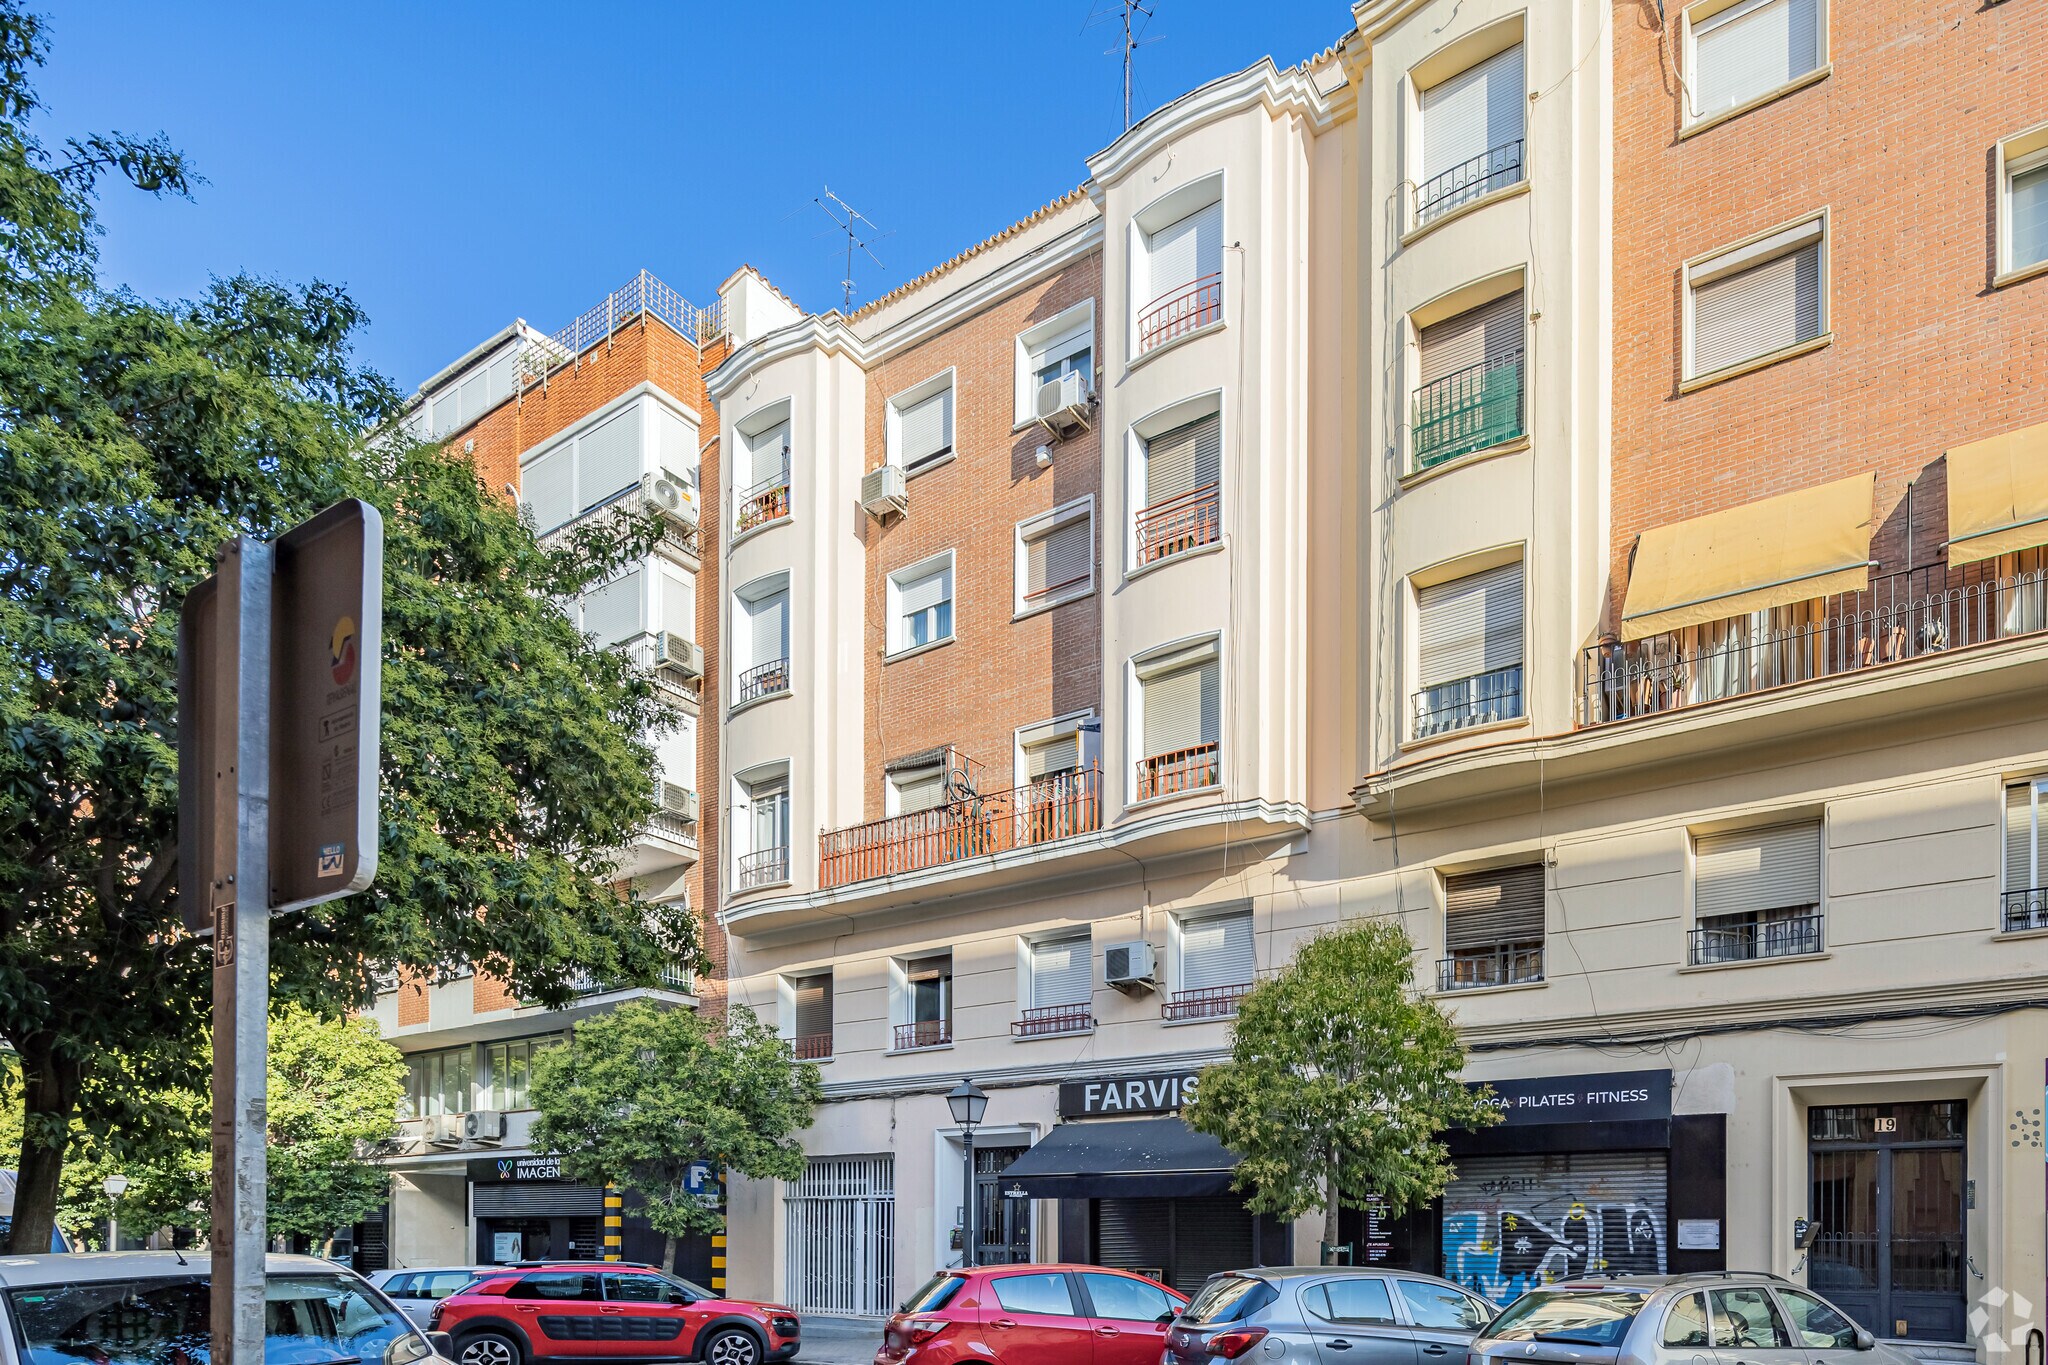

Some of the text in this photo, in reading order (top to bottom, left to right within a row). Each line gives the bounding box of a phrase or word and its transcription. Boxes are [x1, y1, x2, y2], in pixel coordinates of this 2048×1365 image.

[1519, 1093, 1575, 1108] PILATES
[1586, 1089, 1649, 1105] FITNESS
[1877, 1118, 1895, 1132] 19
[516, 1157, 546, 1167] universidad
[546, 1157, 554, 1165] de
[516, 1166, 560, 1179] IMAGEN
